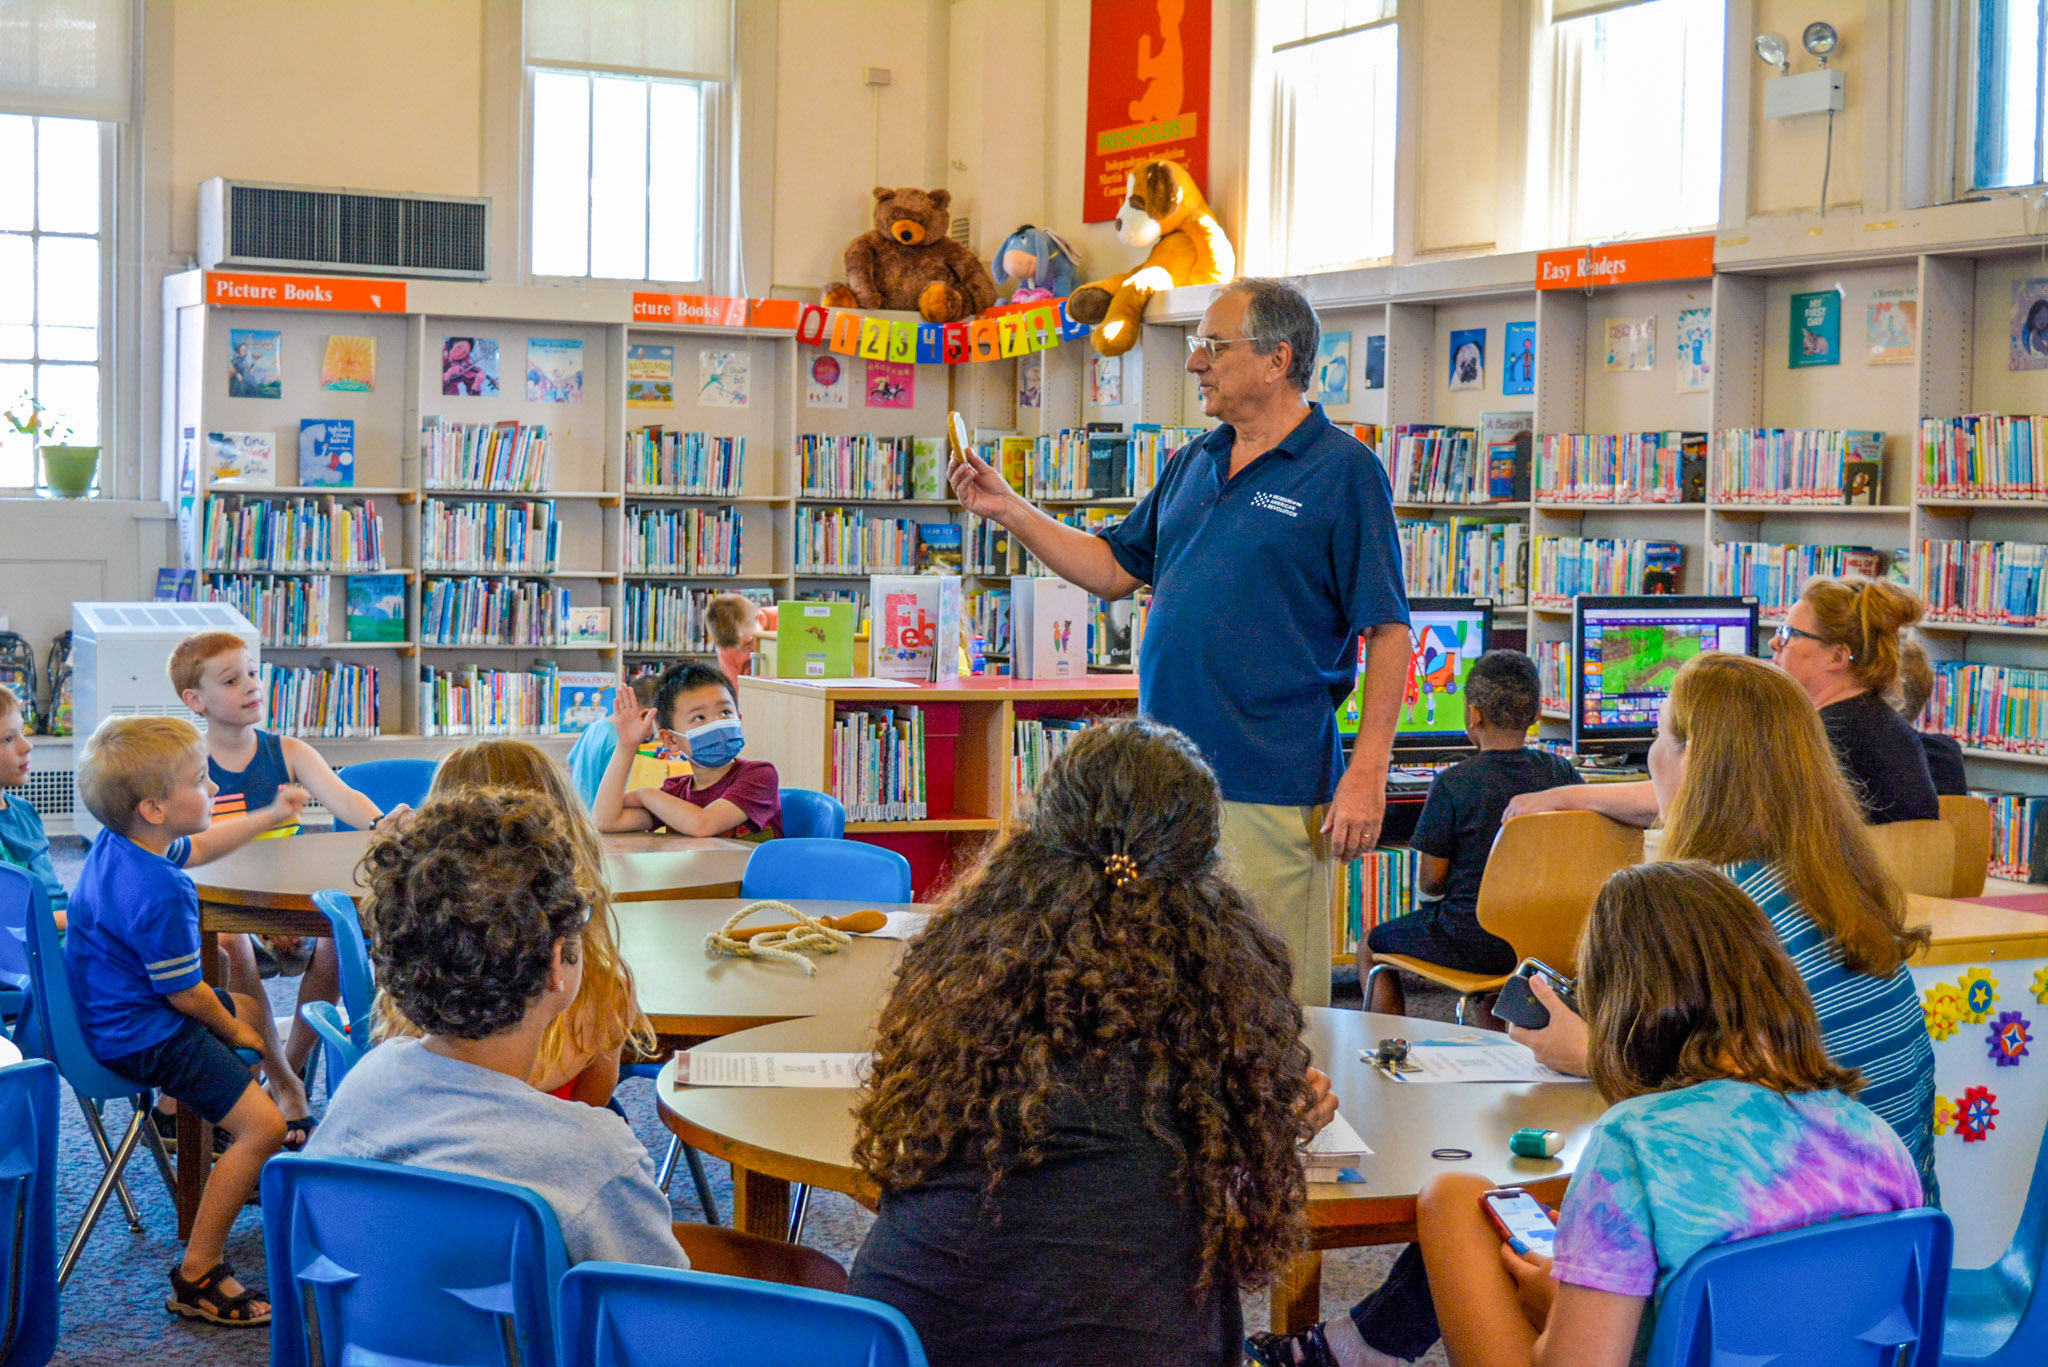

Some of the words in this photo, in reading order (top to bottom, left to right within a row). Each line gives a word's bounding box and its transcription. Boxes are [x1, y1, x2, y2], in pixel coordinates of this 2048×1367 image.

[1100, 119, 1181, 152] PRESCHOOLERS
[1543, 261, 1571, 282] Easy
[1577, 256, 1626, 277] Readers
[215, 280, 277, 299] Picture
[284, 284, 333, 302] Books
[634, 301, 672, 316] cture
[677, 302, 720, 319] Books
[1267, 504, 1298, 518] REVOLUTION
[1270, 499, 1296, 511] AMERICAN
